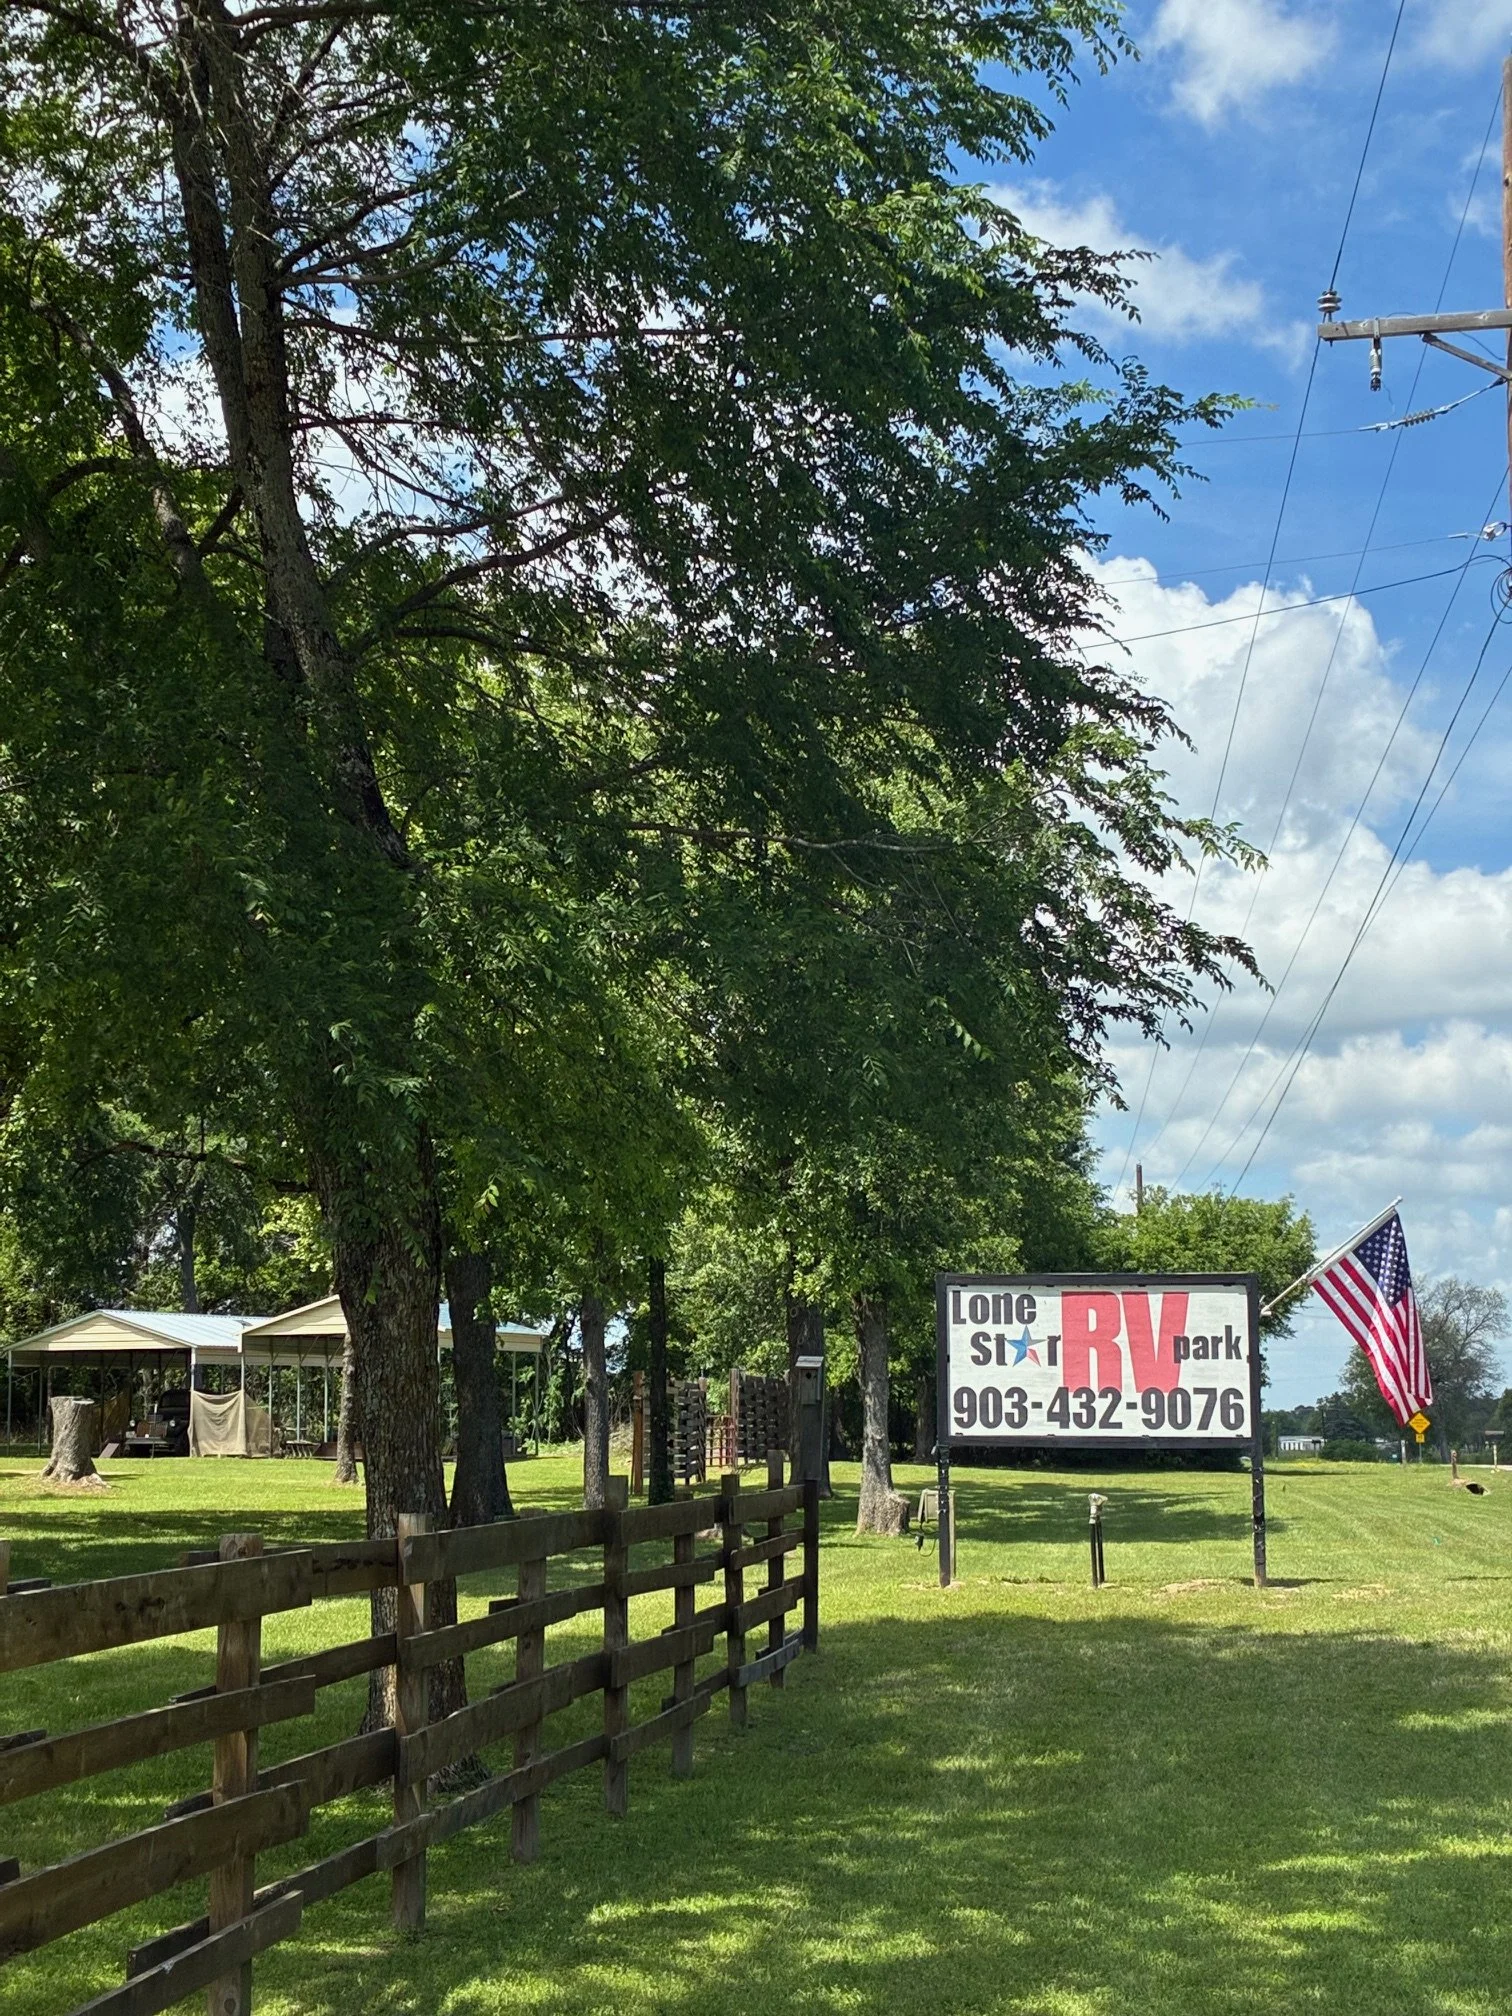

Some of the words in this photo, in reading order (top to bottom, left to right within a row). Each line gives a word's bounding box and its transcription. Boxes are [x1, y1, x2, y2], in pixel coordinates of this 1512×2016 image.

[952, 1290, 1037, 1325] Lone
[970, 1331, 1062, 1367] Str
[1061, 1290, 1190, 1393] RV
[1173, 1324, 1243, 1364] park
[953, 1386, 1245, 1431] 903-432-9076
